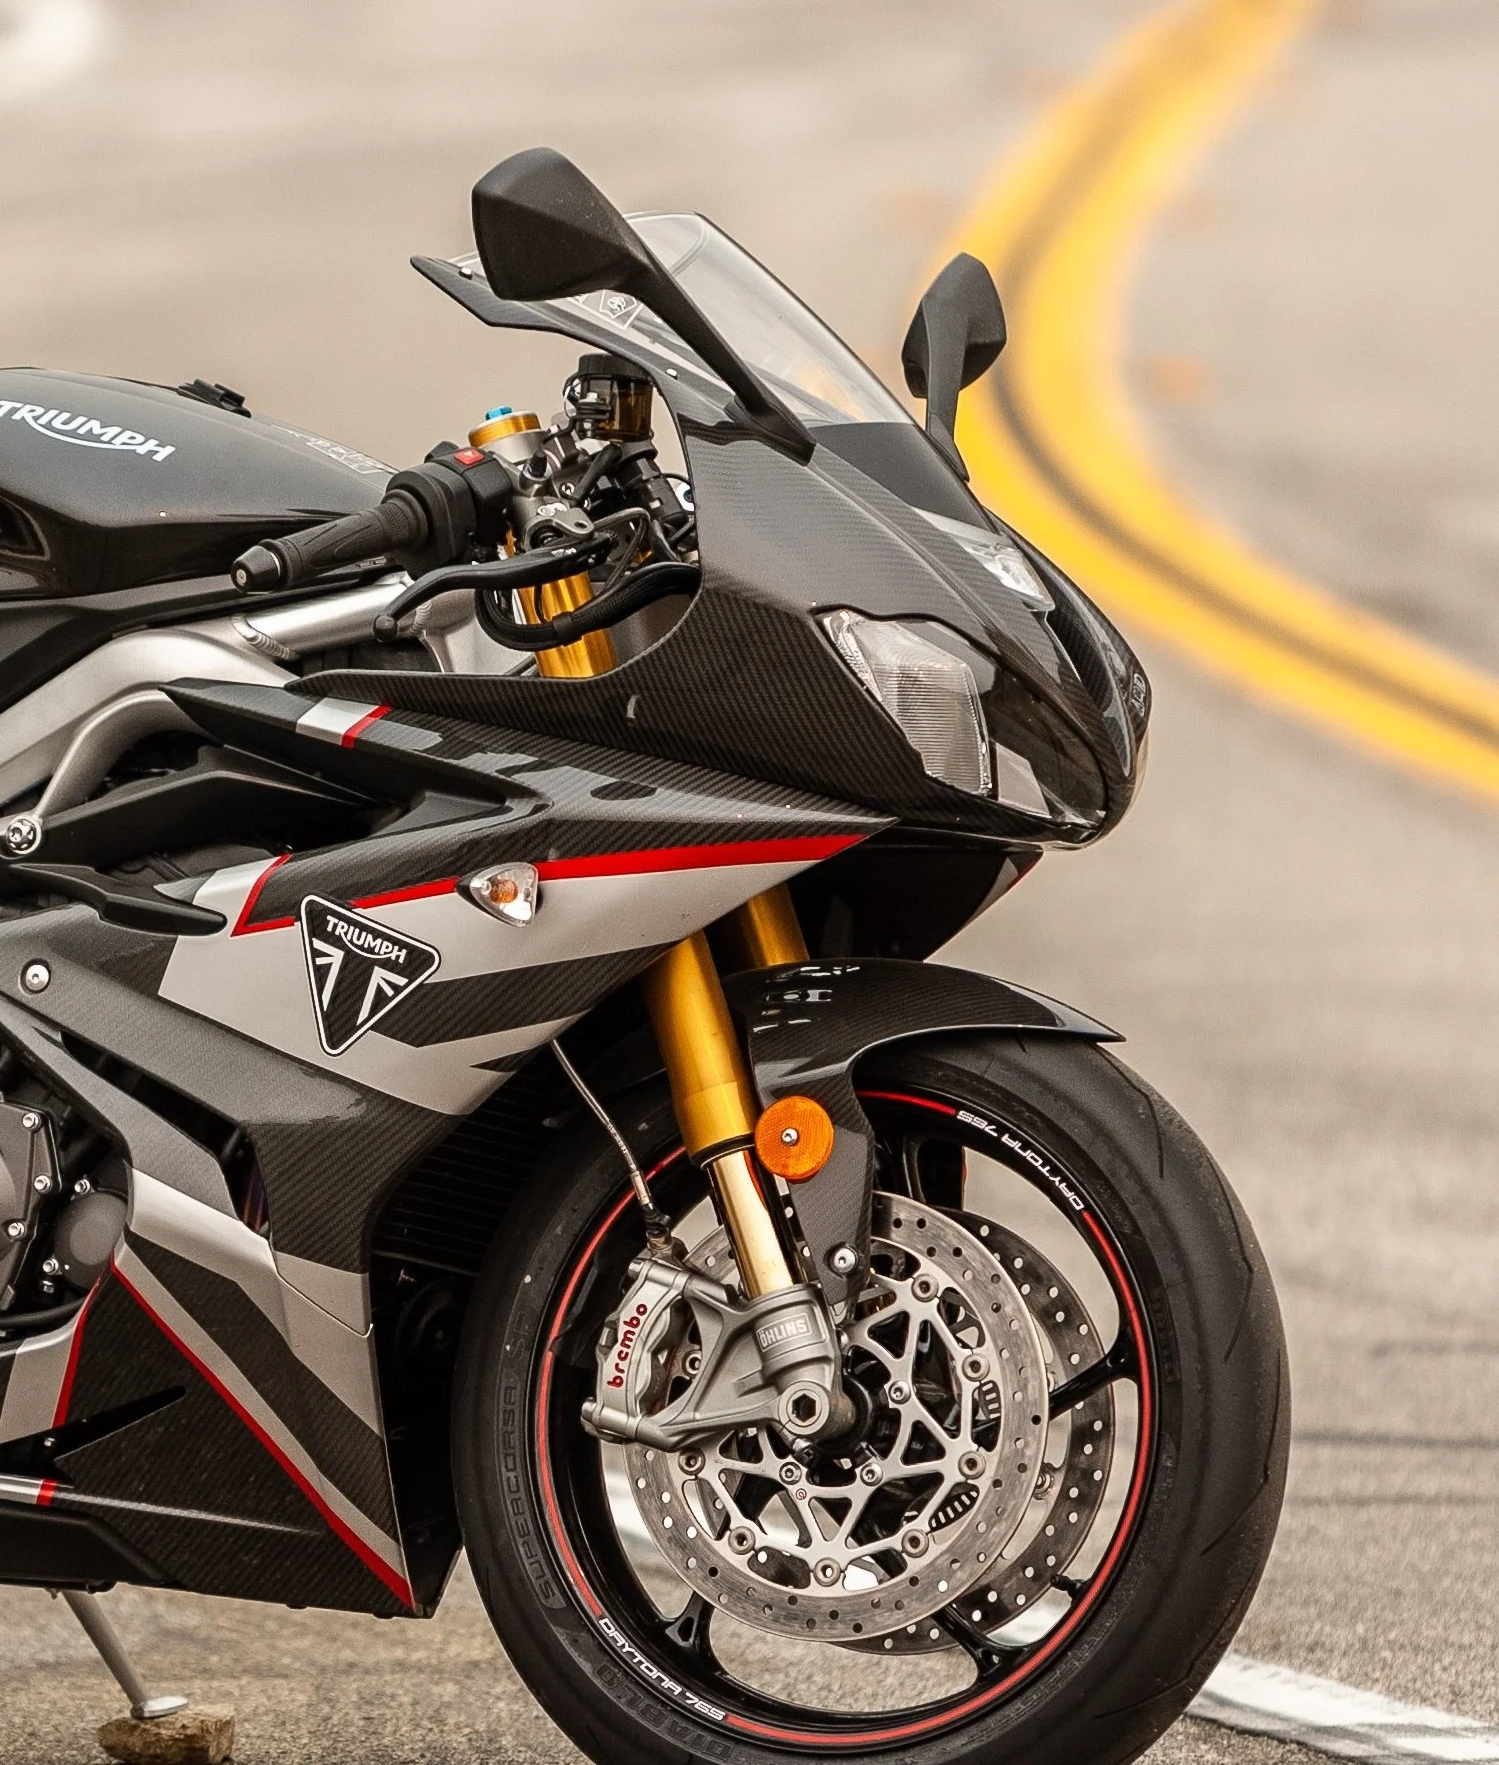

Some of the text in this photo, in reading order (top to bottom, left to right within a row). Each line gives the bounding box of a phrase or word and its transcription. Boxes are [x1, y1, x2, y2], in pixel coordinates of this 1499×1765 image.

[326, 915, 407, 964] TRIUMPH
[956, 1109, 999, 1138] 765
[1001, 1132, 1085, 1212] DAYTONA
[606, 1303, 649, 1389] brembo
[758, 1316, 808, 1350] ÖHLINS
[598, 1617, 727, 1722] DAYTONA 765
